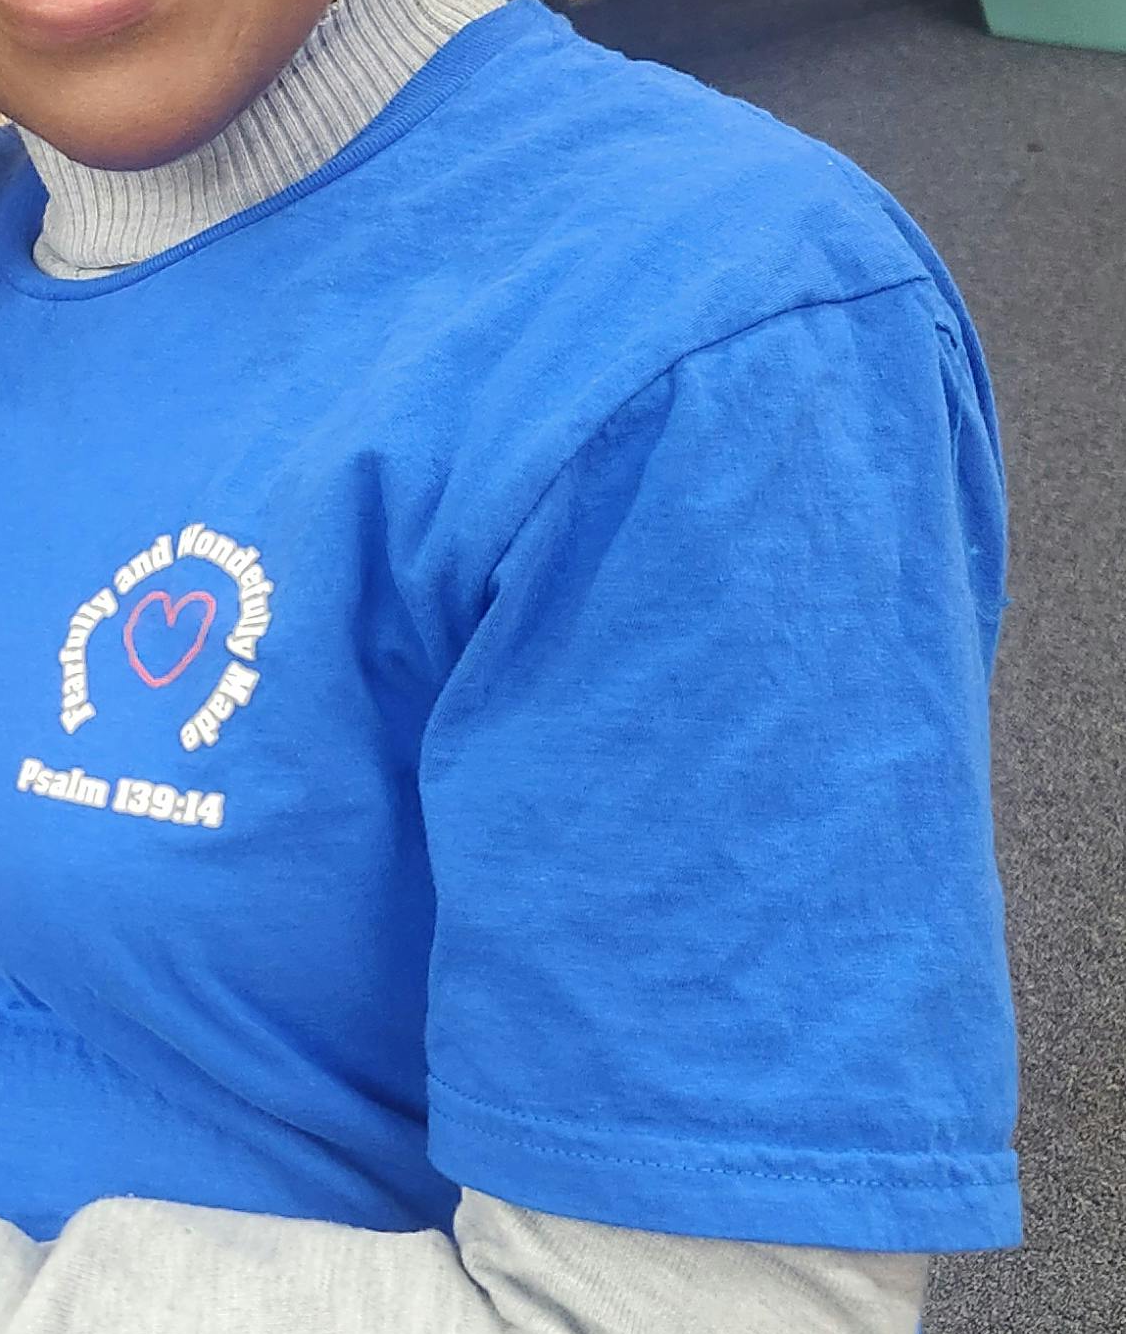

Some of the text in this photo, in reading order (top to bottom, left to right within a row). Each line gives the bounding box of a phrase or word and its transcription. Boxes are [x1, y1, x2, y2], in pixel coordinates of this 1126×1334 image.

[58, 587, 119, 735] Fearfully
[113, 533, 174, 595] and
[179, 660, 260, 752] Made
[17, 759, 225, 828] Psalm 139:14
